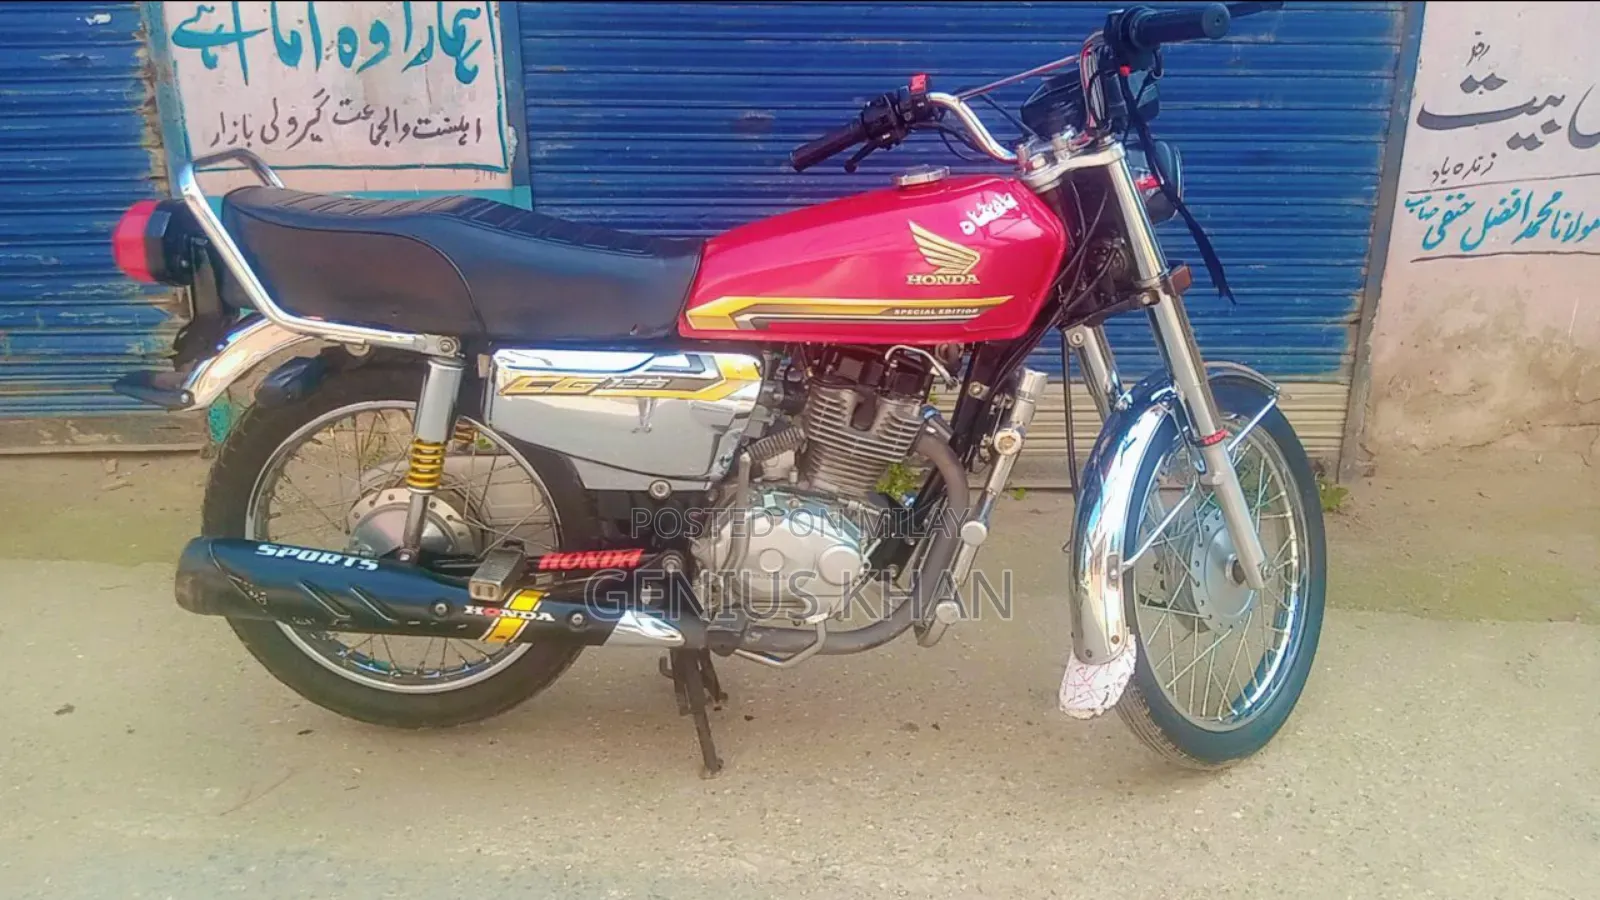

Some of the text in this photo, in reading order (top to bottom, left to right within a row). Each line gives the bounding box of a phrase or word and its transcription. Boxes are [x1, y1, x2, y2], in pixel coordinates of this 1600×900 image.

[1510, 190, 1563, 245] محمد
[906, 273, 980, 287] HONDA
[893, 307, 980, 316] SPECIAL EDITION
[255, 544, 380, 571] SPORTS
[538, 549, 645, 570] HONDA
[464, 605, 556, 622] HONDA
